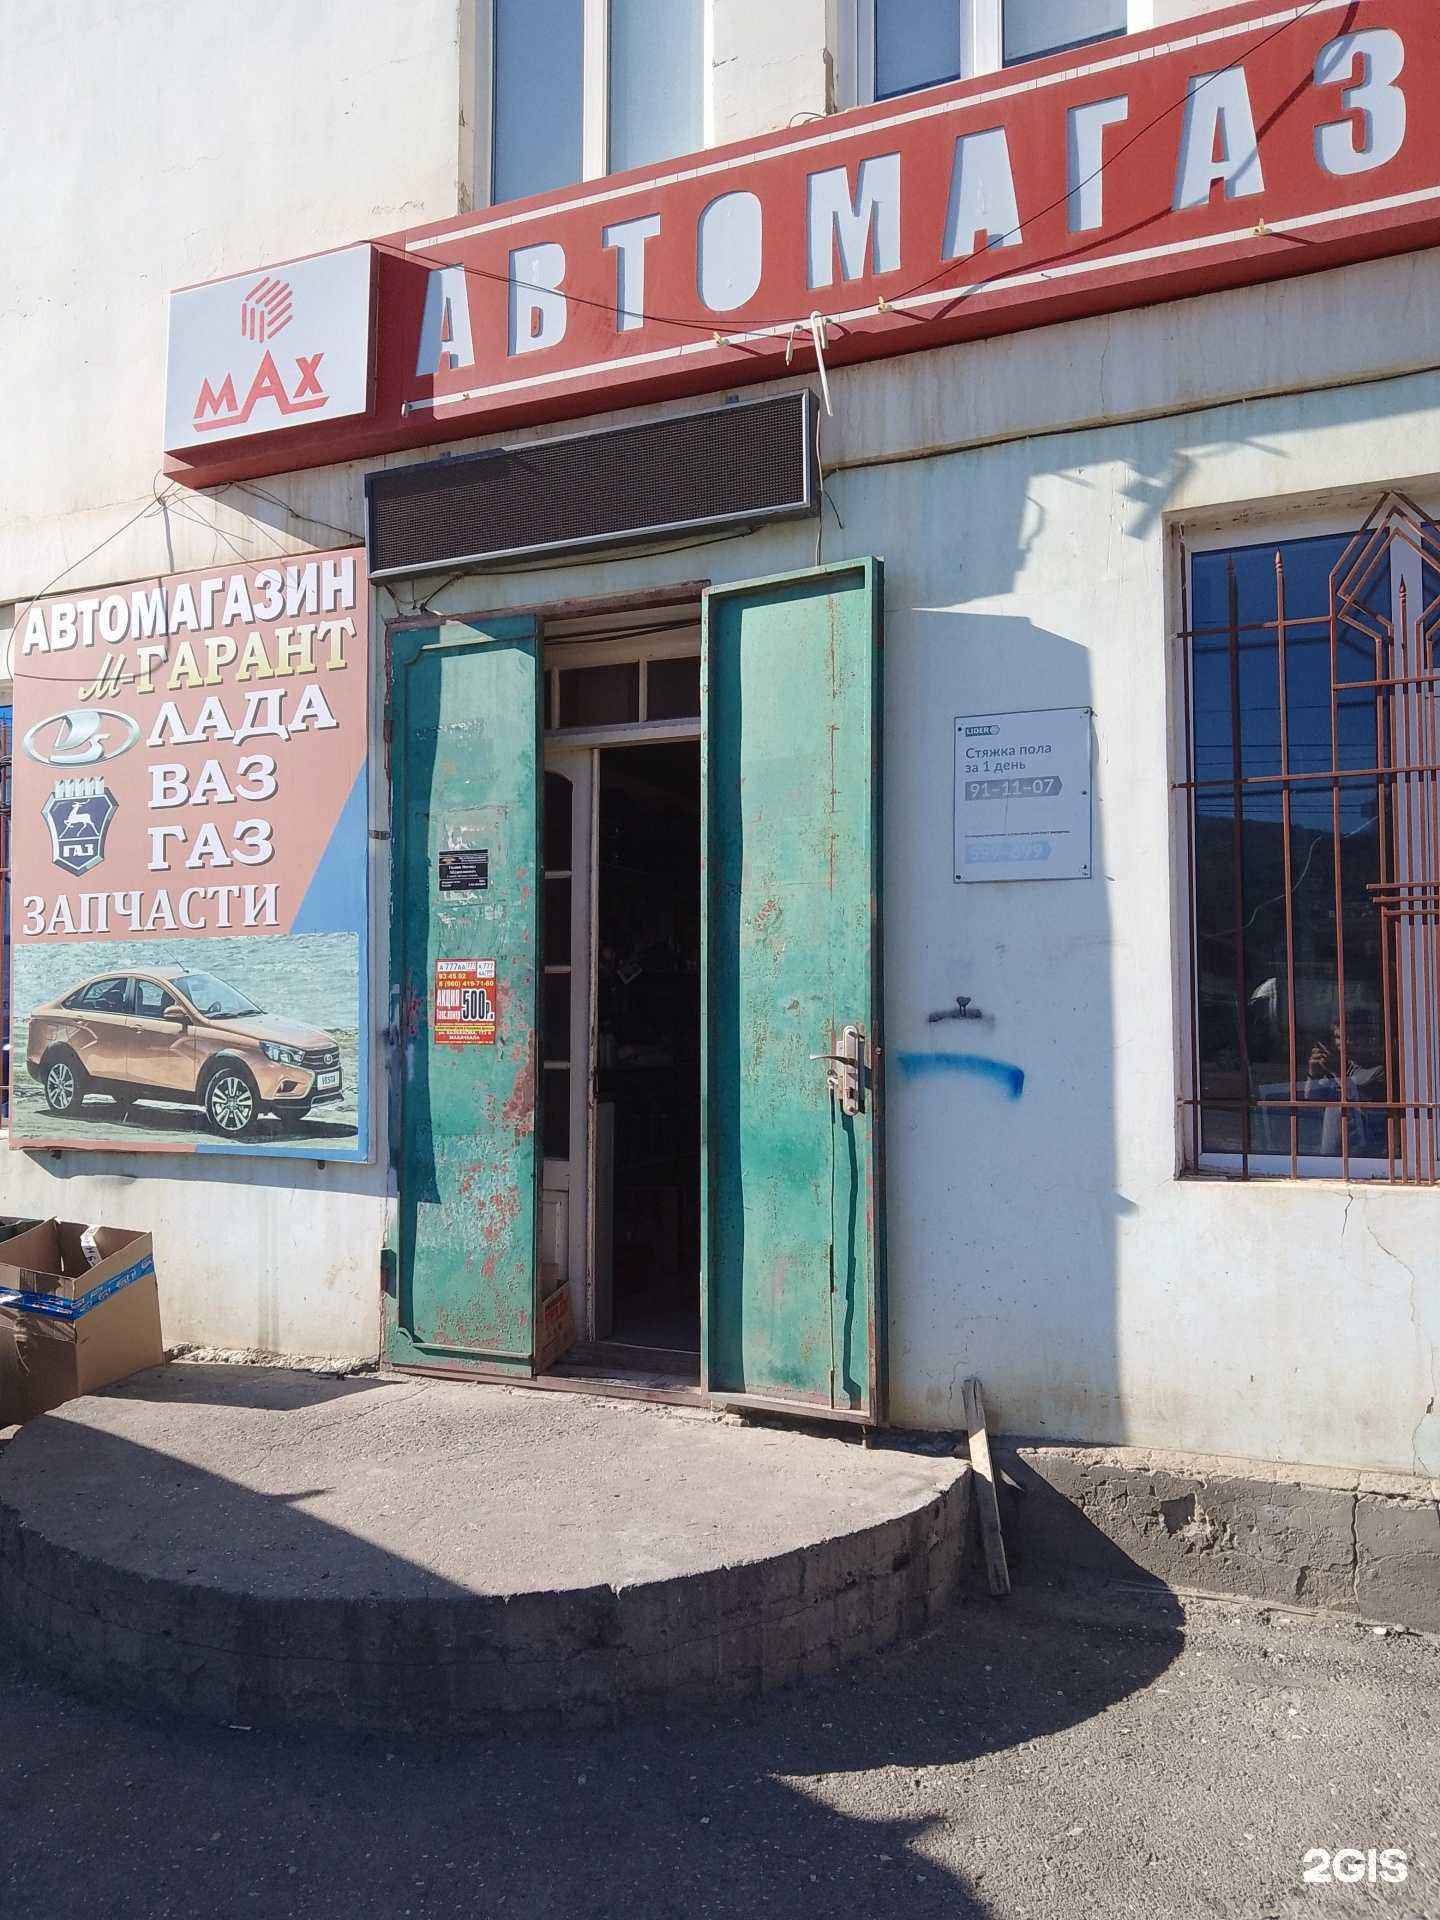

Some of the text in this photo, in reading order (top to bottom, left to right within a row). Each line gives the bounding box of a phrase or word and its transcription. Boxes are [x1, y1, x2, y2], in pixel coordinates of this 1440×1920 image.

[22, 557, 357, 655] АВТОМАГАЗИН
[146, 684, 339, 747] ЛАДА
[965, 744, 1052, 759] Стяжка пола
[965, 760, 1026, 774] за 1 день
[148, 754, 278, 809] ВАЗ
[969, 779, 1055, 798] 91-11-07
[63, 844, 94, 857] ГАЗ
[147, 818, 277, 871] ГАЗ
[23, 883, 279, 936] ЗАПЧАСТИ
